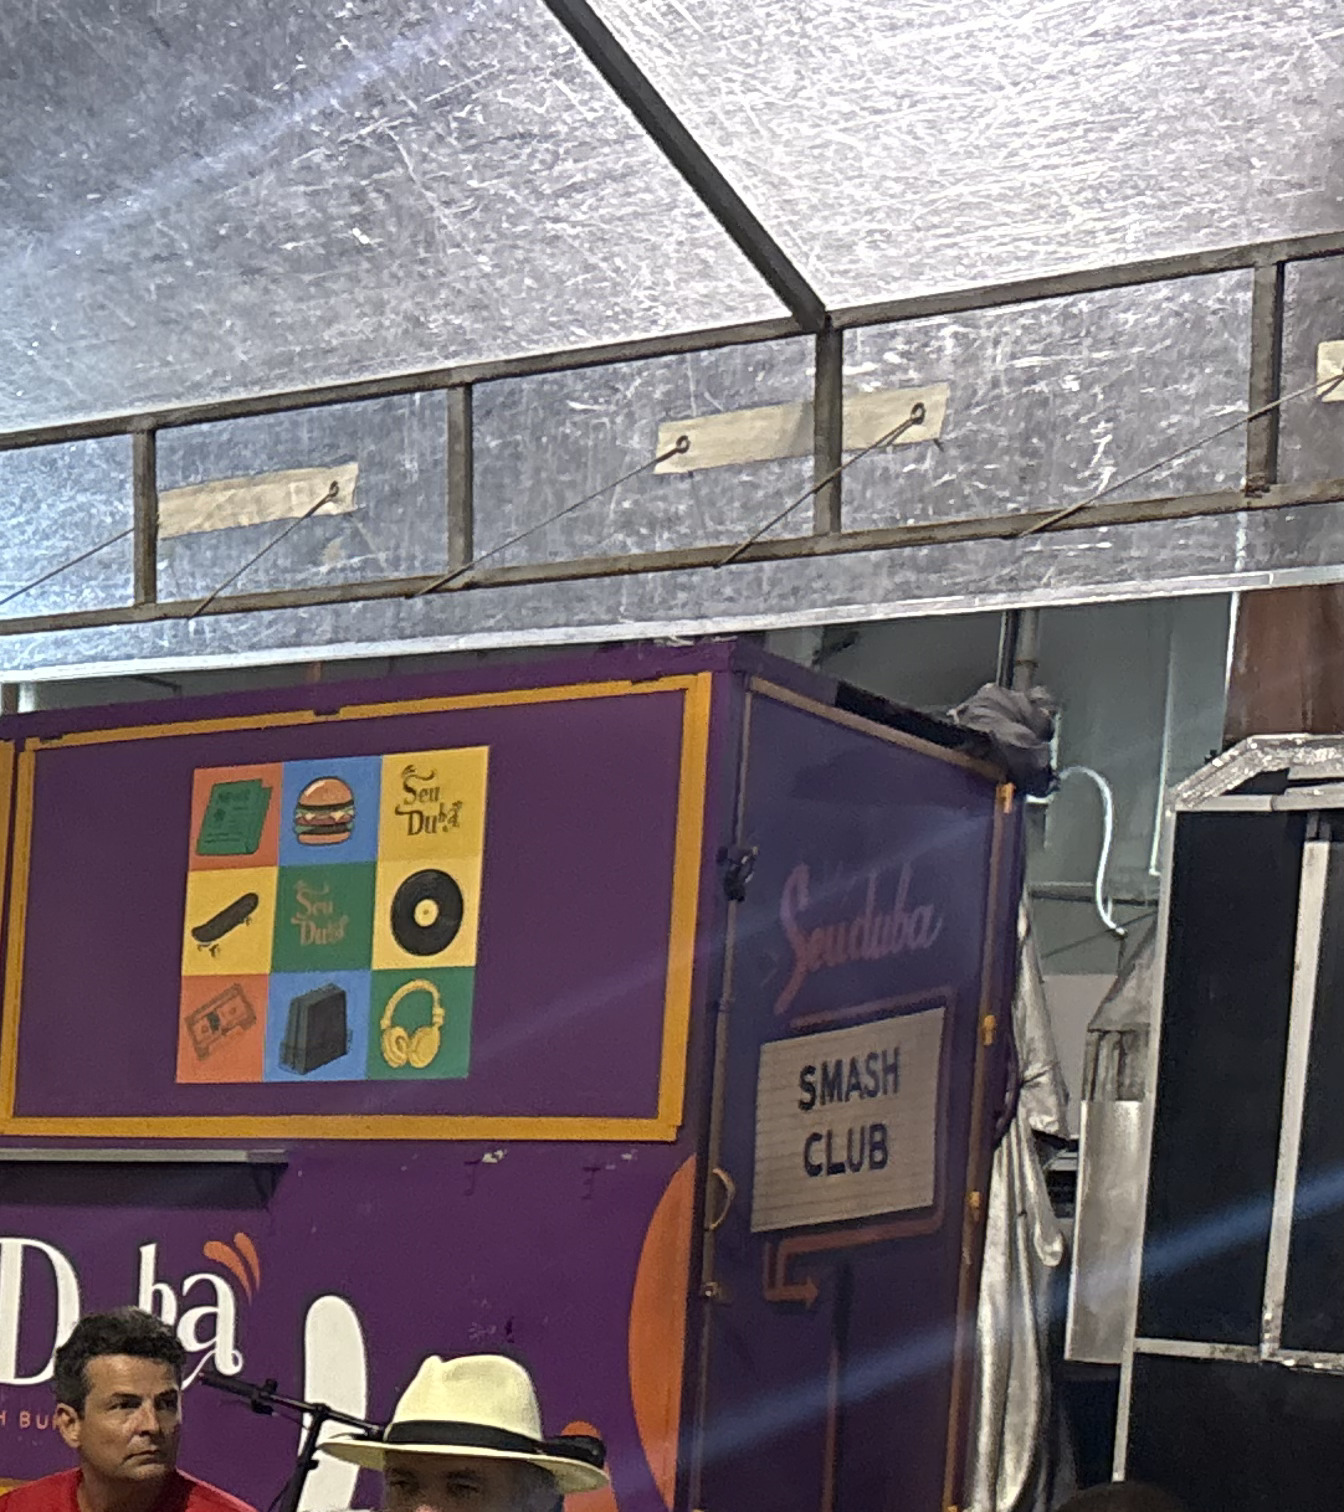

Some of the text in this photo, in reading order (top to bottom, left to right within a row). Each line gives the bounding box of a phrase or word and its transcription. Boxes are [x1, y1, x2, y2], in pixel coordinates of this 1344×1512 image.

[401, 765, 440, 805] Seu
[798, 1046, 900, 1111] SMASH
[803, 1123, 888, 1177] CLUB
